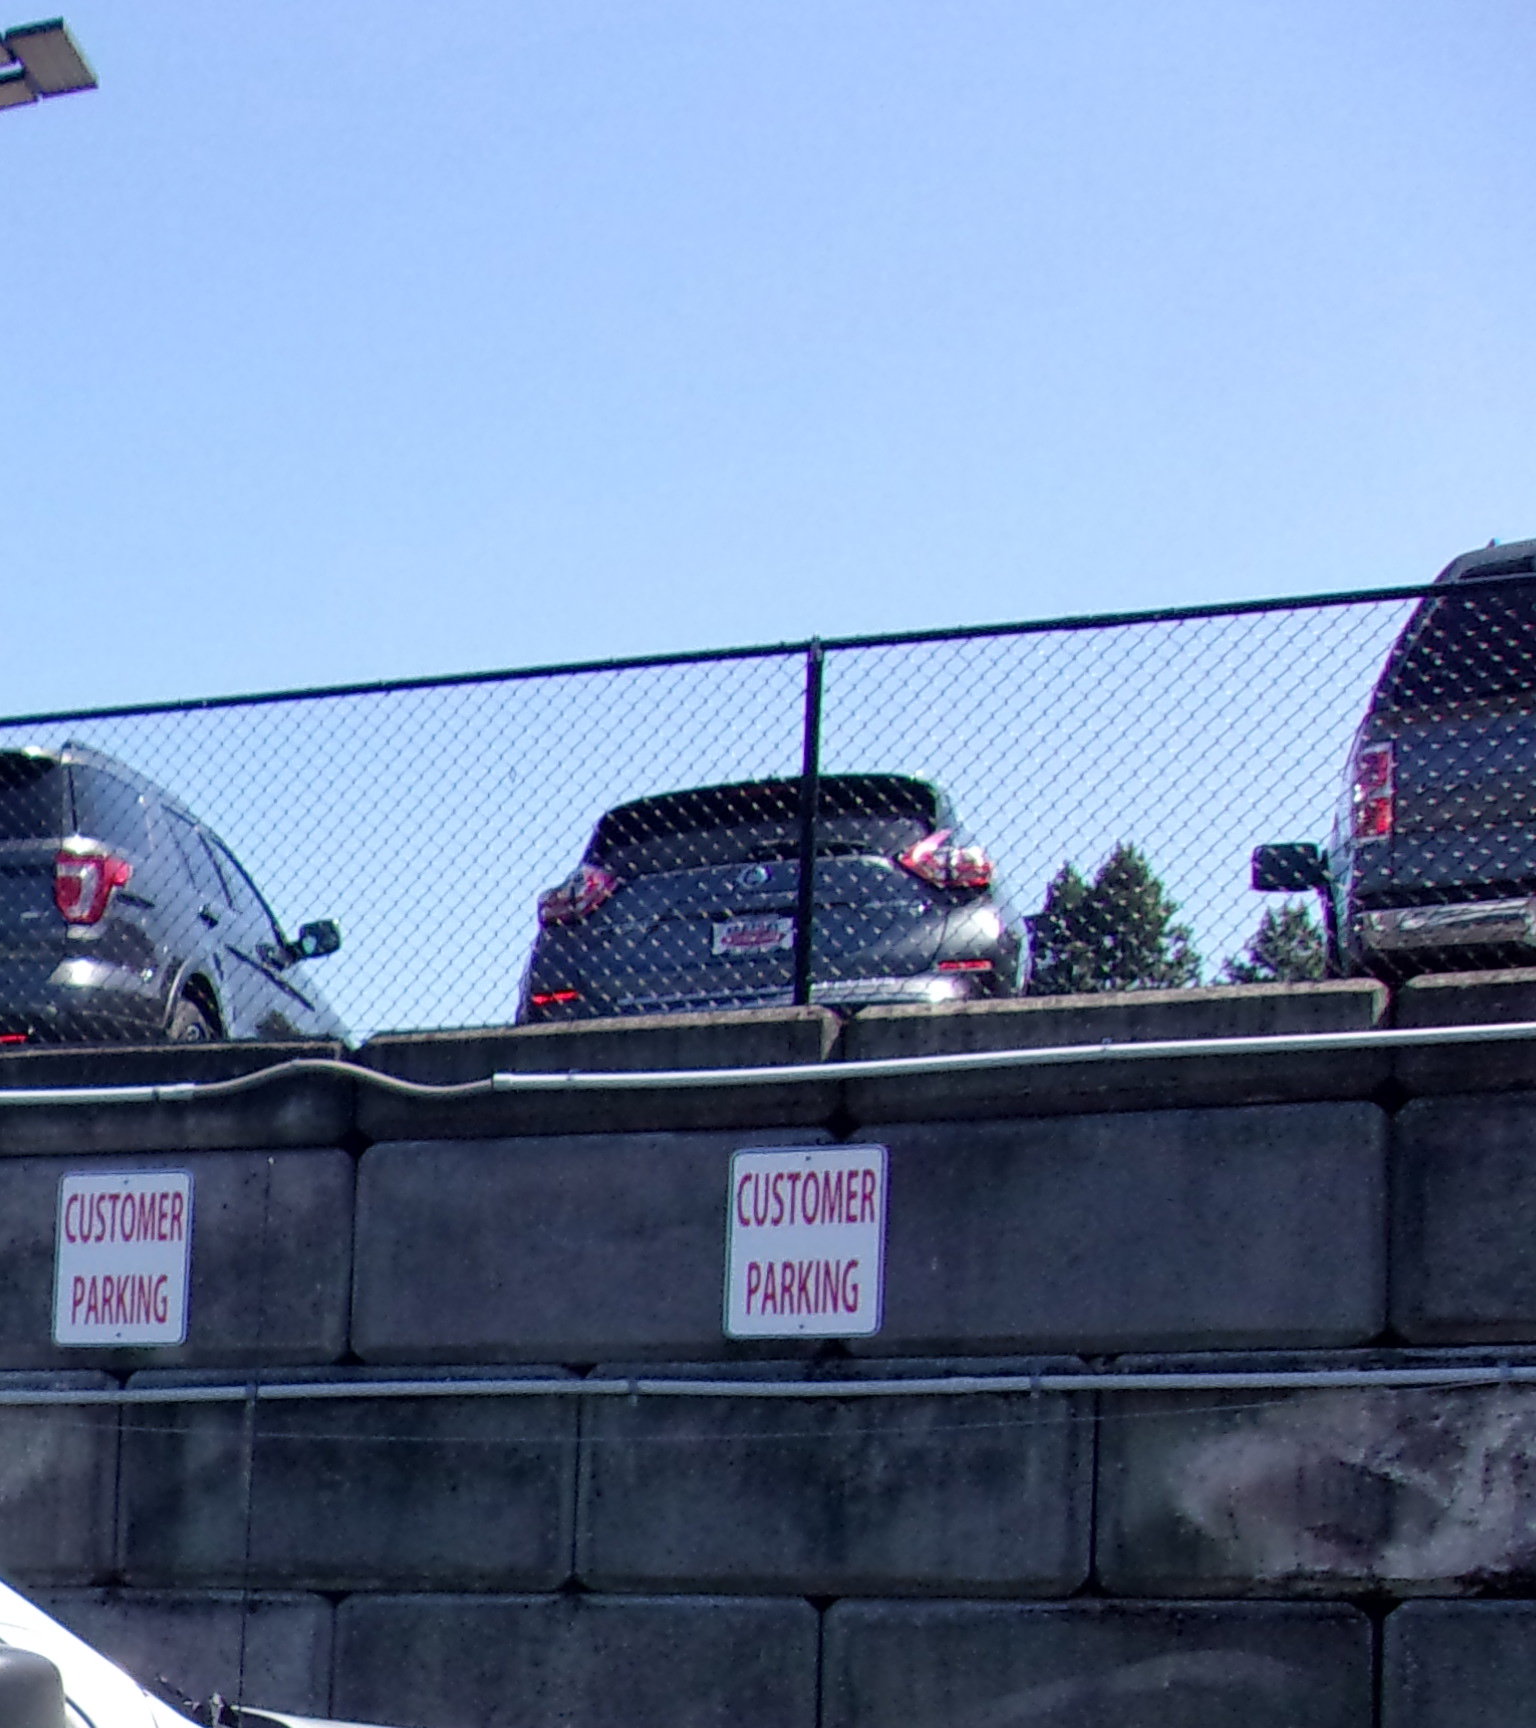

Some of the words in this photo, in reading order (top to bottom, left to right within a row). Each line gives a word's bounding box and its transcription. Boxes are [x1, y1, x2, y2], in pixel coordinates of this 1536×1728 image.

[64, 1191, 184, 1243] CUSTOMER
[737, 1168, 877, 1227] CUSTOMER
[71, 1274, 169, 1325] PARKING
[745, 1259, 860, 1315] PARKING
